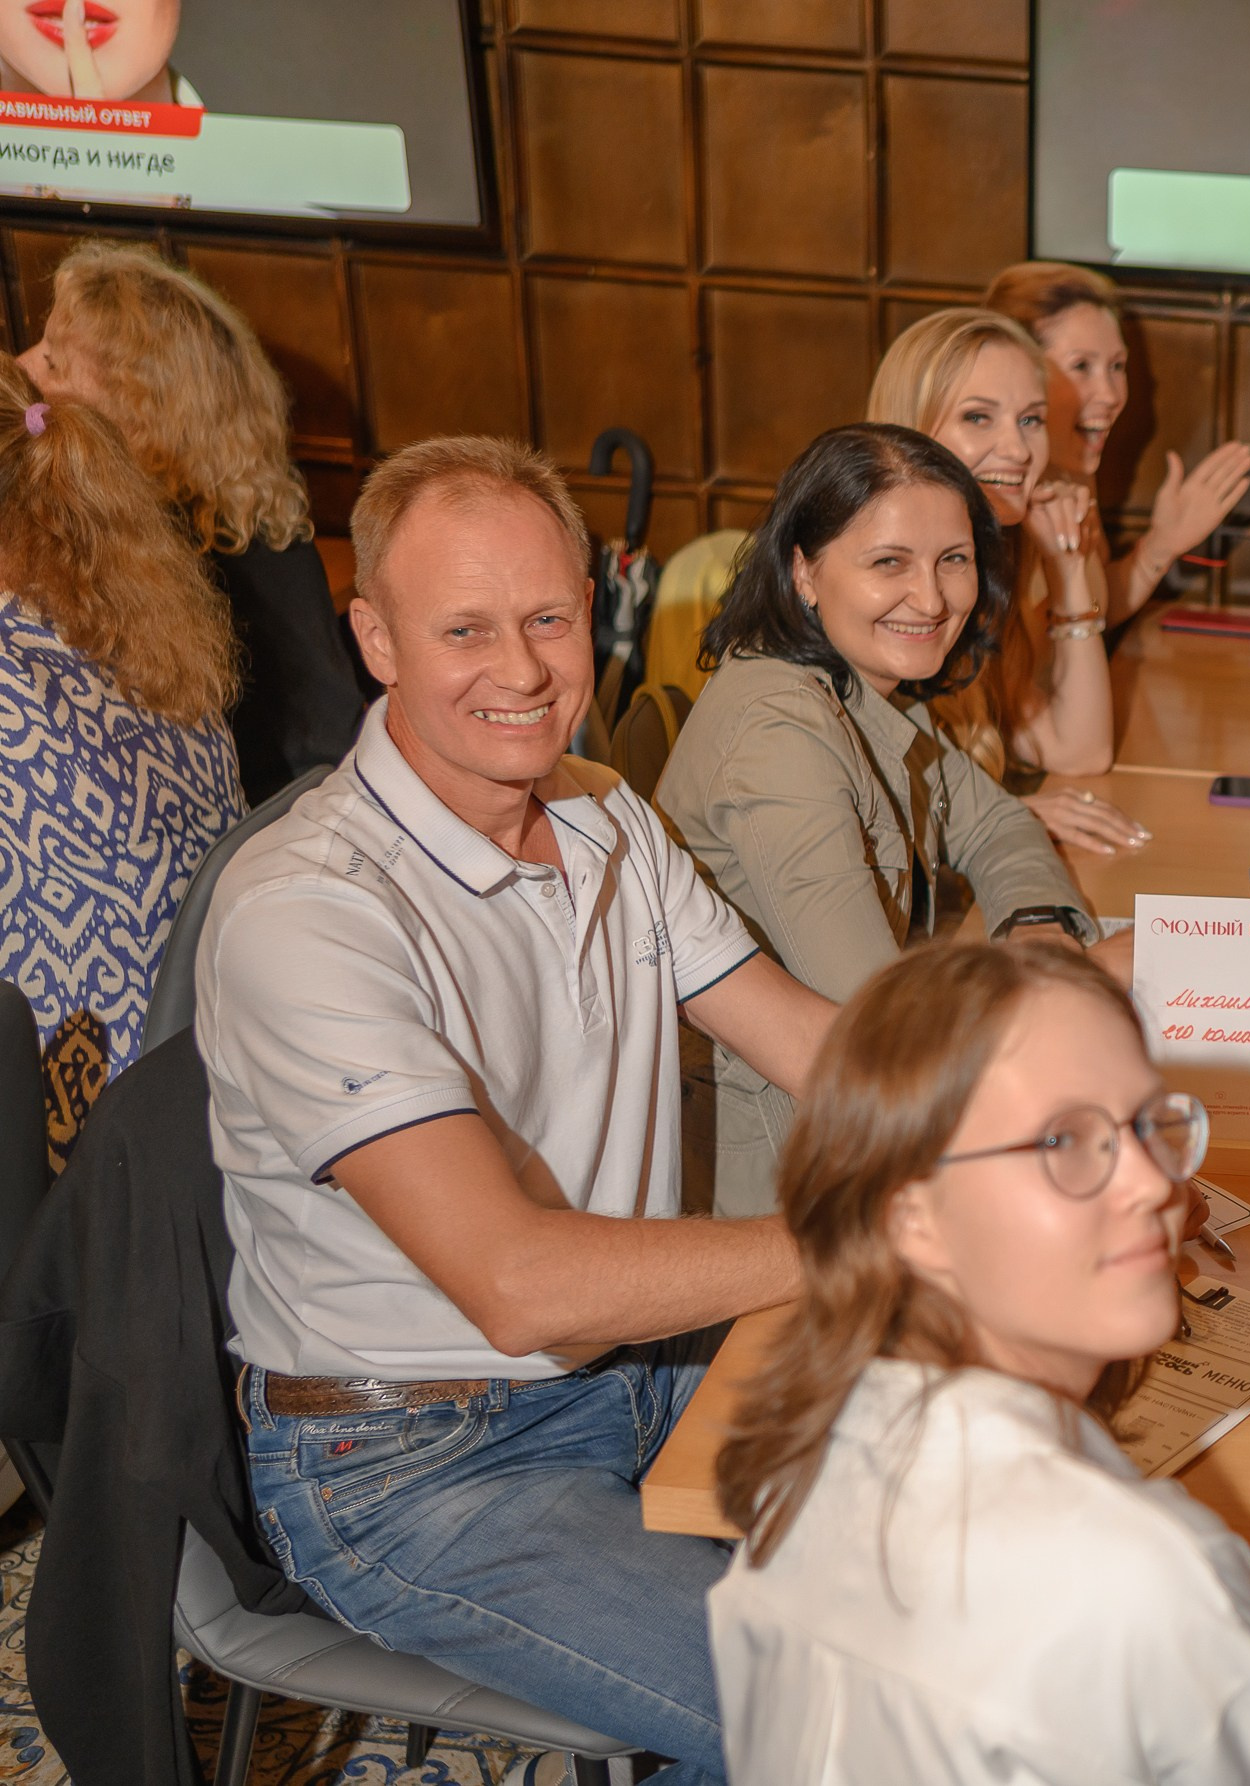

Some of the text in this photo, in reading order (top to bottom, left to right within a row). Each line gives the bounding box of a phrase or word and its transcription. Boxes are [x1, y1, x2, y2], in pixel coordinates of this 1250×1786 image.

[100, 108, 151, 128] ОТВЕТ
[87, 148, 100, 168] и
[108, 151, 175, 177] нигде
[1151, 917, 1243, 936] МОДНЫЙ
[1162, 1024, 1194, 1040] его
